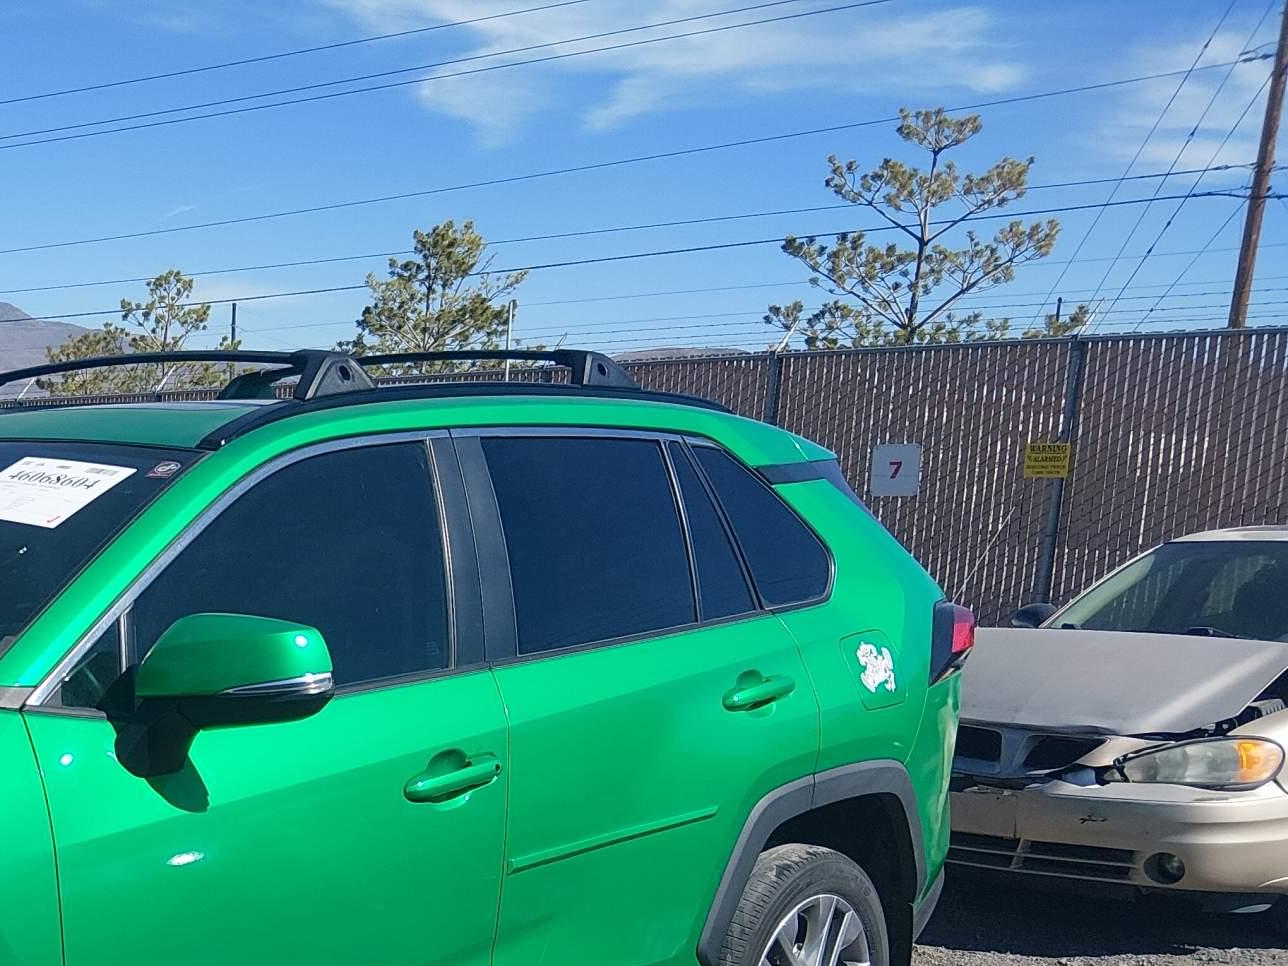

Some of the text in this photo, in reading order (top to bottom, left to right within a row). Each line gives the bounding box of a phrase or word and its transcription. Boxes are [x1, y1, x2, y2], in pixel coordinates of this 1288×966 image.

[1030, 444, 1067, 453] WARNING
[889, 461, 903, 479] 7
[8, 470, 101, 490] 46068604
